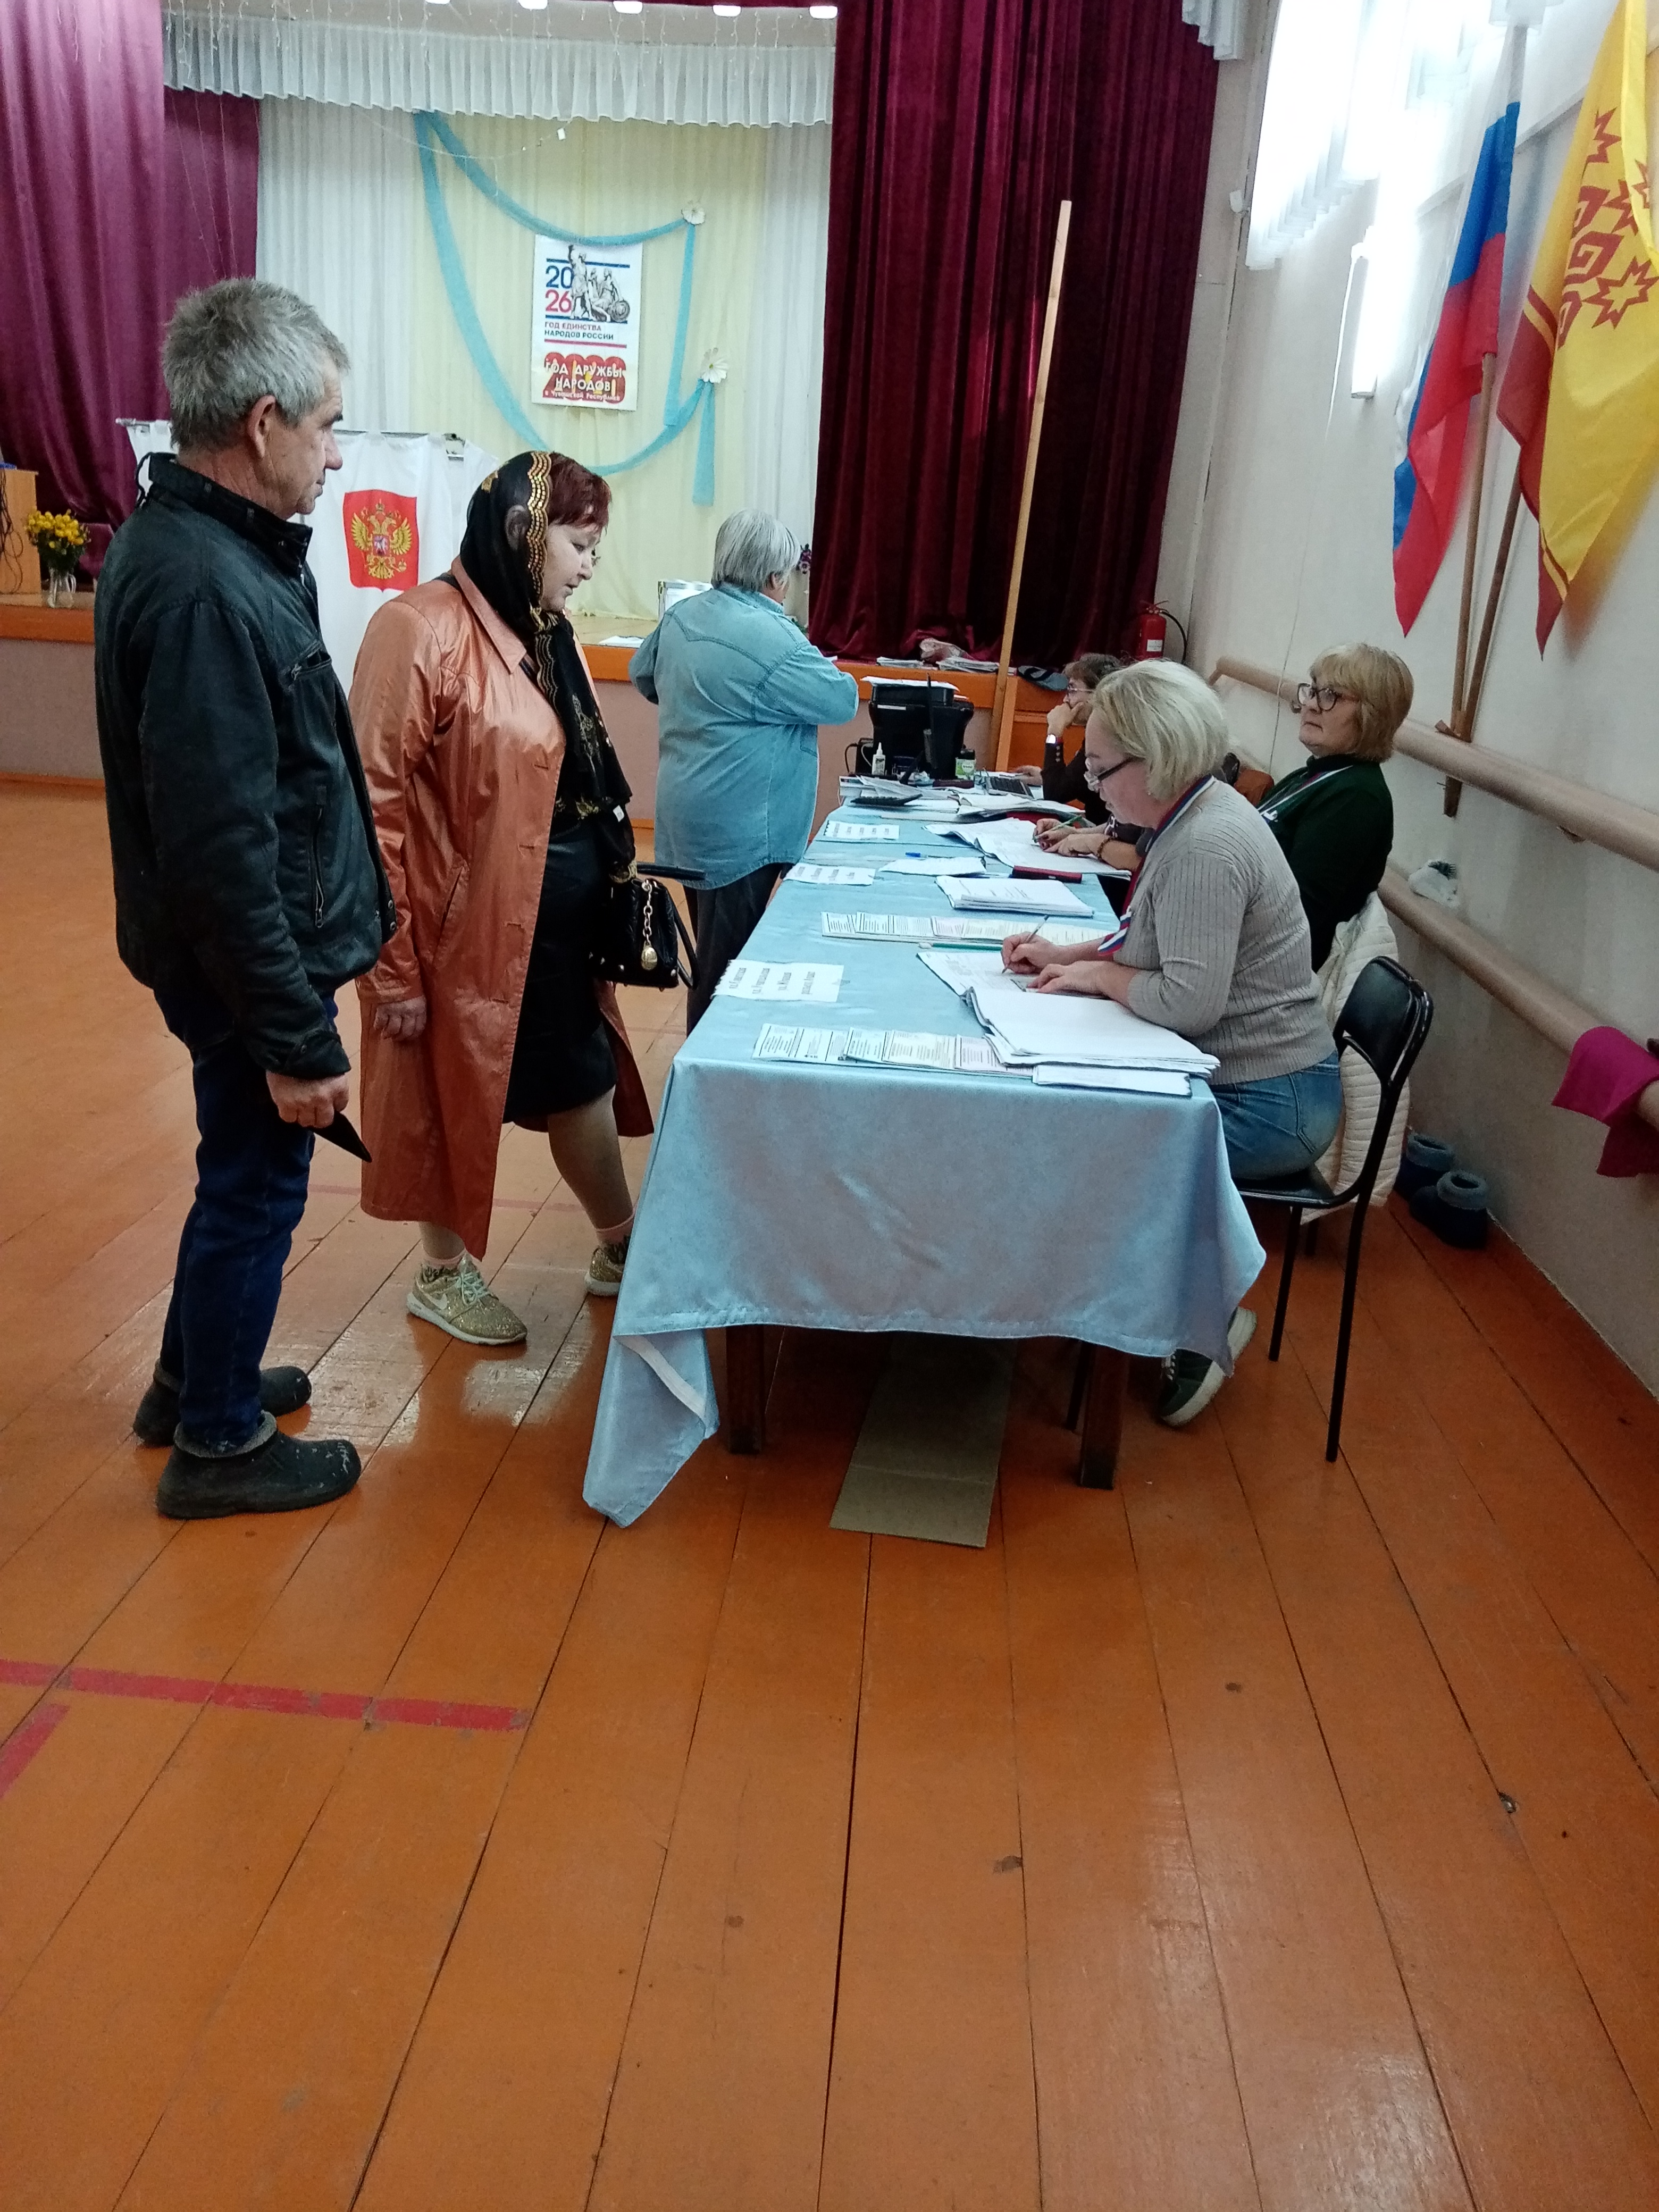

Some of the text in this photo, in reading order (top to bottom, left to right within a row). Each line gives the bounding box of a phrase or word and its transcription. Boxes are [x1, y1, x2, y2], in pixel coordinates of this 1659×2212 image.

[546, 265, 574, 289] 20
[545, 289, 572, 313] 26
[562, 322, 601, 331] ЕДИНСТВА
[544, 330, 614, 340] НАРОДОВ РОССИИ
[546, 362, 622, 378] ГОД ДРУЖБЫ
[556, 377, 611, 391] НАРОДОВ
